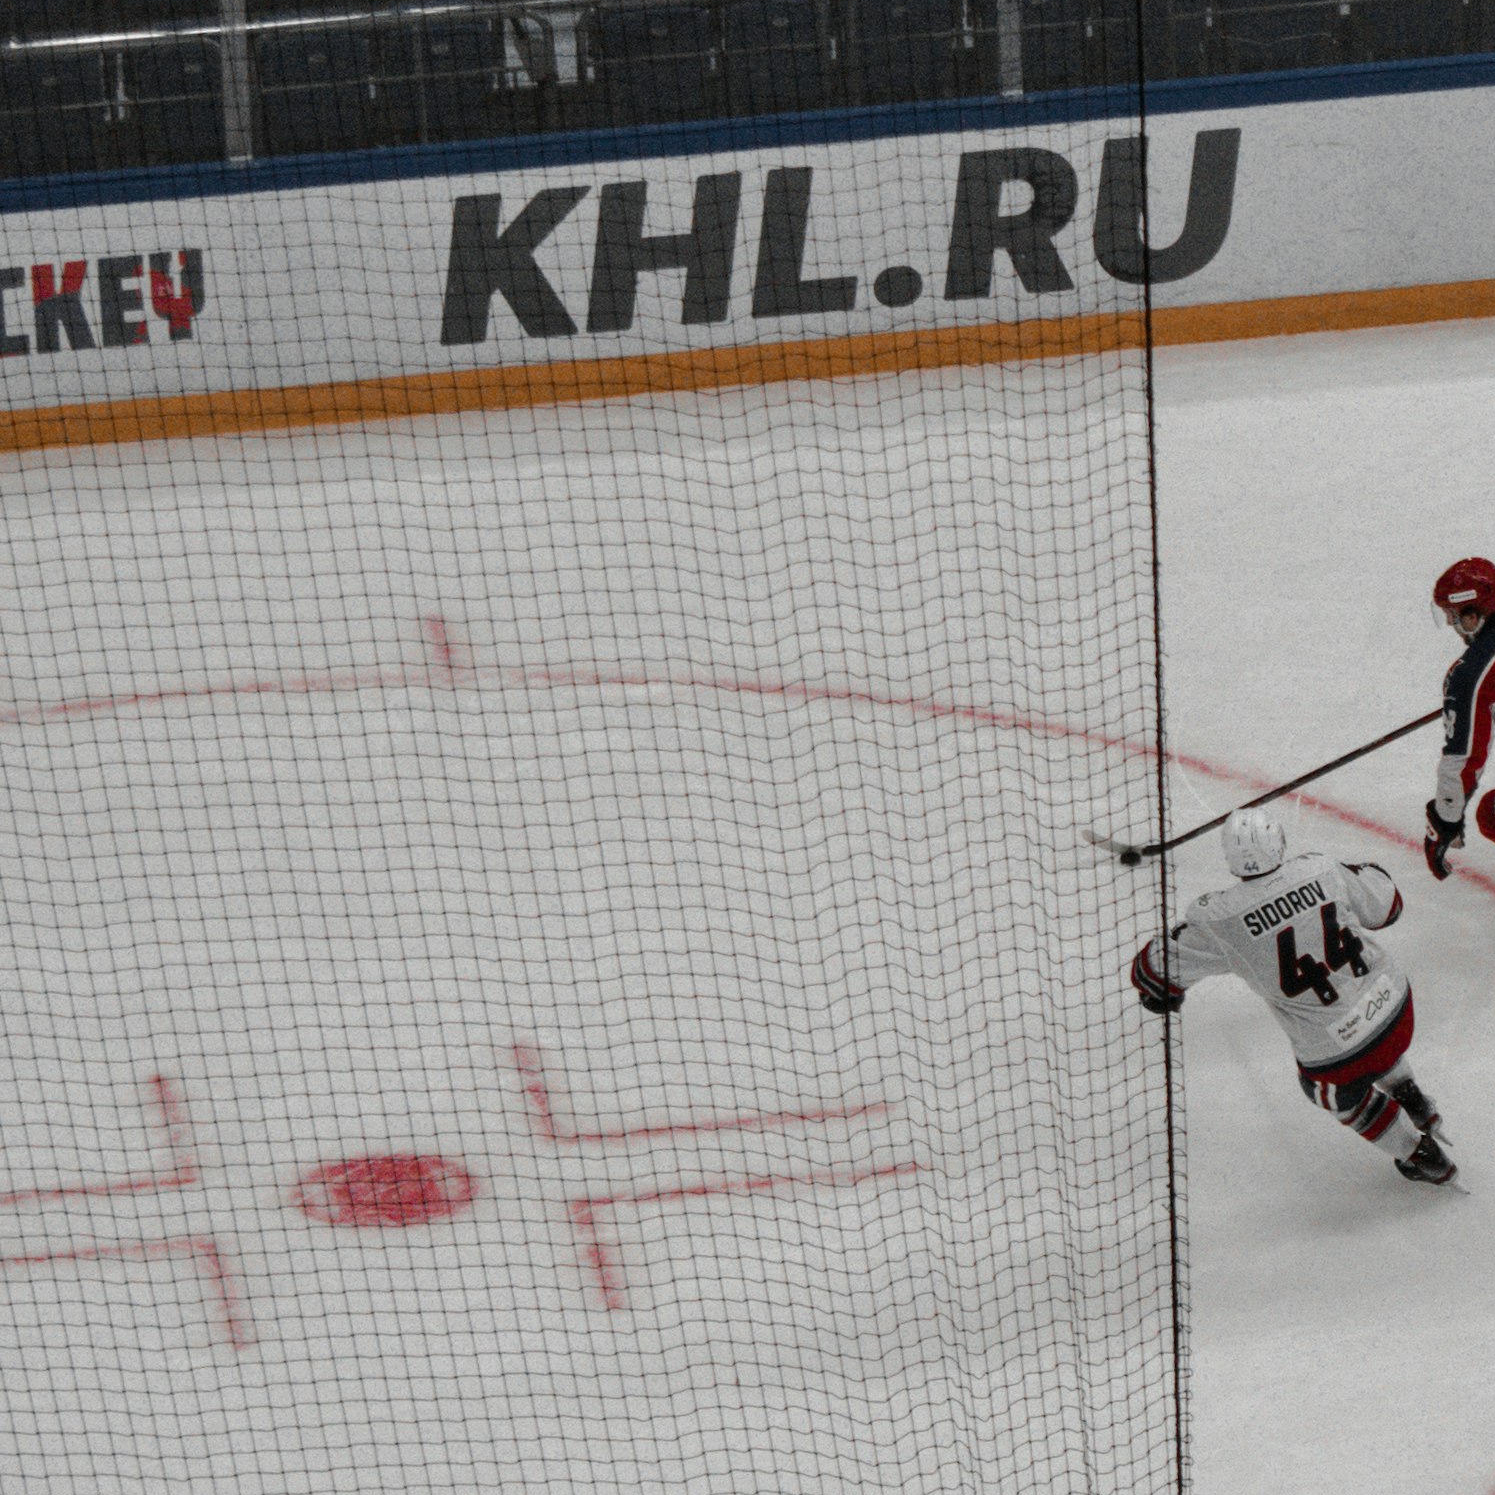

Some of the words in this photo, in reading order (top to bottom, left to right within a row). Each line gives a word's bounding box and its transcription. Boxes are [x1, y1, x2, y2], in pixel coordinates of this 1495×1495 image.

[440, 128, 1241, 346] KHL.RU
[0, 248, 205, 359] CKEY
[1243, 880, 1327, 937] SIDOROV
[1276, 901, 1370, 1006] 44
